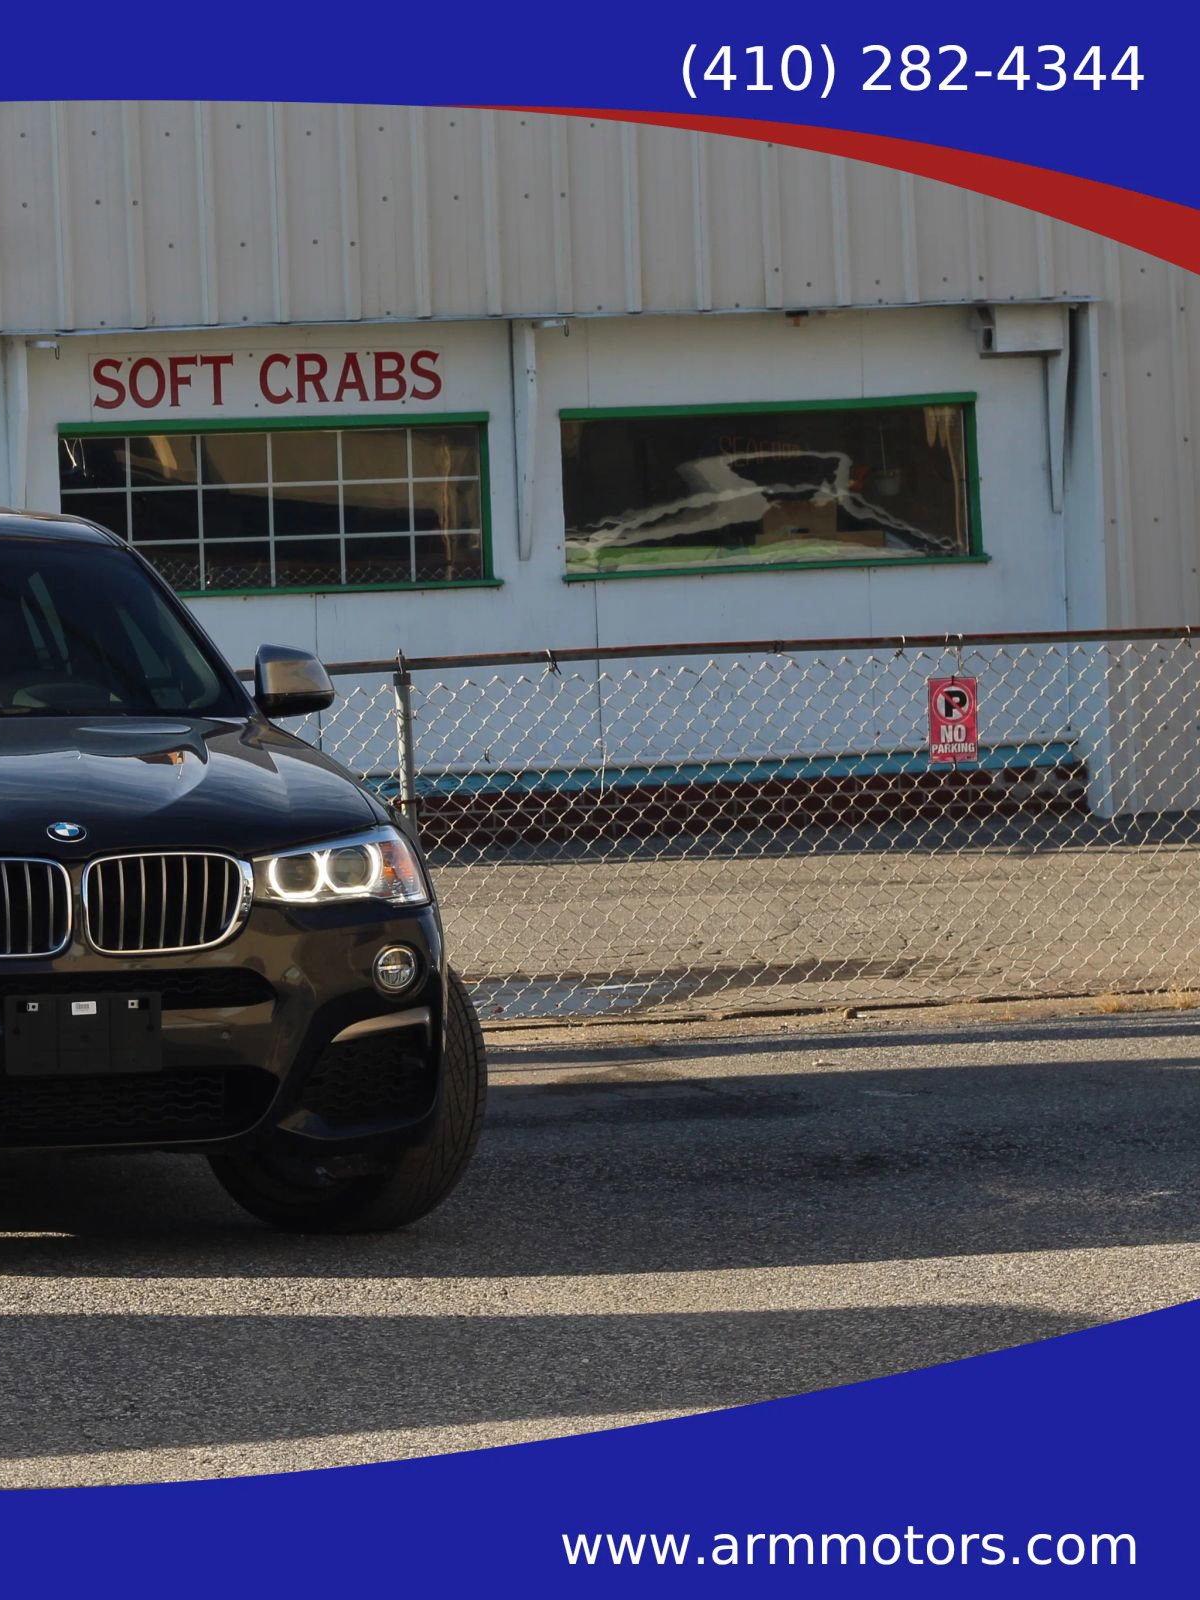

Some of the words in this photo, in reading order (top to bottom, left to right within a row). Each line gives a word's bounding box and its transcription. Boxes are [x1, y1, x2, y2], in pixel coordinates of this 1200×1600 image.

[92, 352, 234, 410] SOFT
[258, 349, 443, 405] CRABS
[940, 724, 967, 743] NO
[931, 743, 976, 754] PARKING
